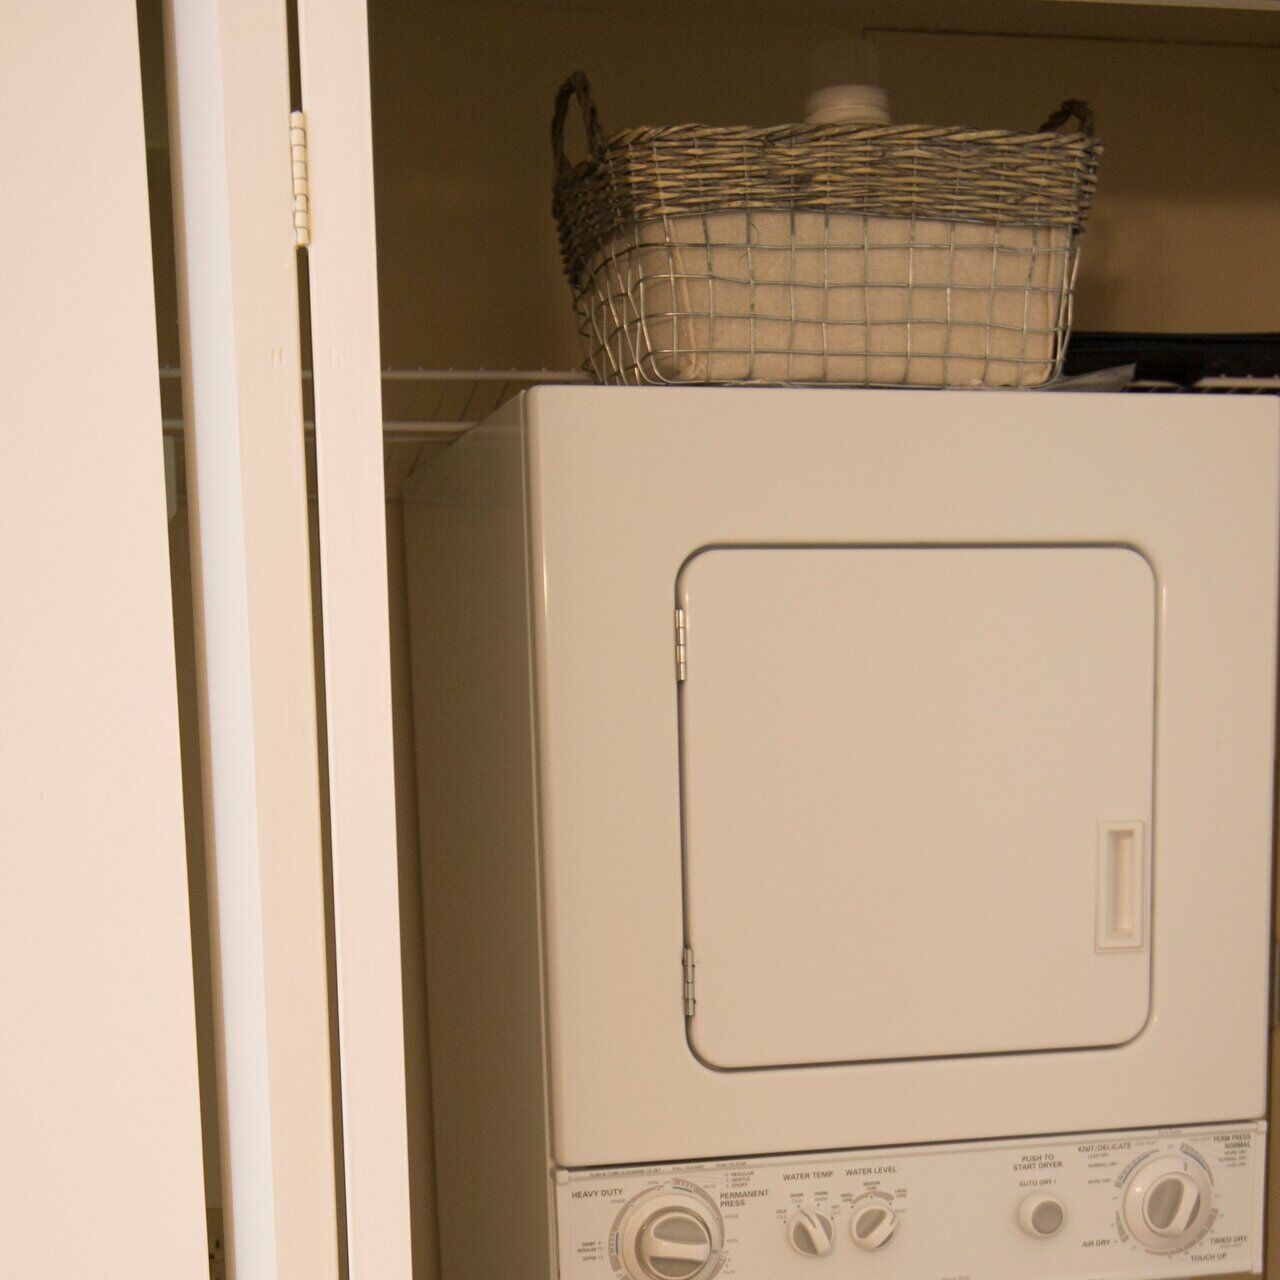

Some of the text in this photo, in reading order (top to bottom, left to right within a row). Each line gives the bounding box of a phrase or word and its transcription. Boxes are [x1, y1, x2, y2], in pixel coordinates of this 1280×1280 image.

[1213, 1134, 1230, 1142] PERM
[1231, 1133, 1251, 1141] PRESS
[1077, 1142, 1132, 1153] KNIT/DELICATE
[1021, 1153, 1054, 1162] PUSH TO
[845, 1165, 897, 1177] WATER LEVEL
[1013, 1161, 1063, 1171] START DRYER
[782, 1170, 833, 1181] WATER TEMP
[1018, 1179, 1037, 1187] AUTO
[571, 1188, 623, 1199] HEAVY DUTY
[719, 1189, 769, 1200] PERMANENT
[719, 1199, 746, 1208] PRESS
[1082, 1239, 1111, 1248] AIR DRY
[1209, 1235, 1248, 1245] TIMED DRY
[1190, 1254, 1215, 1262] TOUCH
